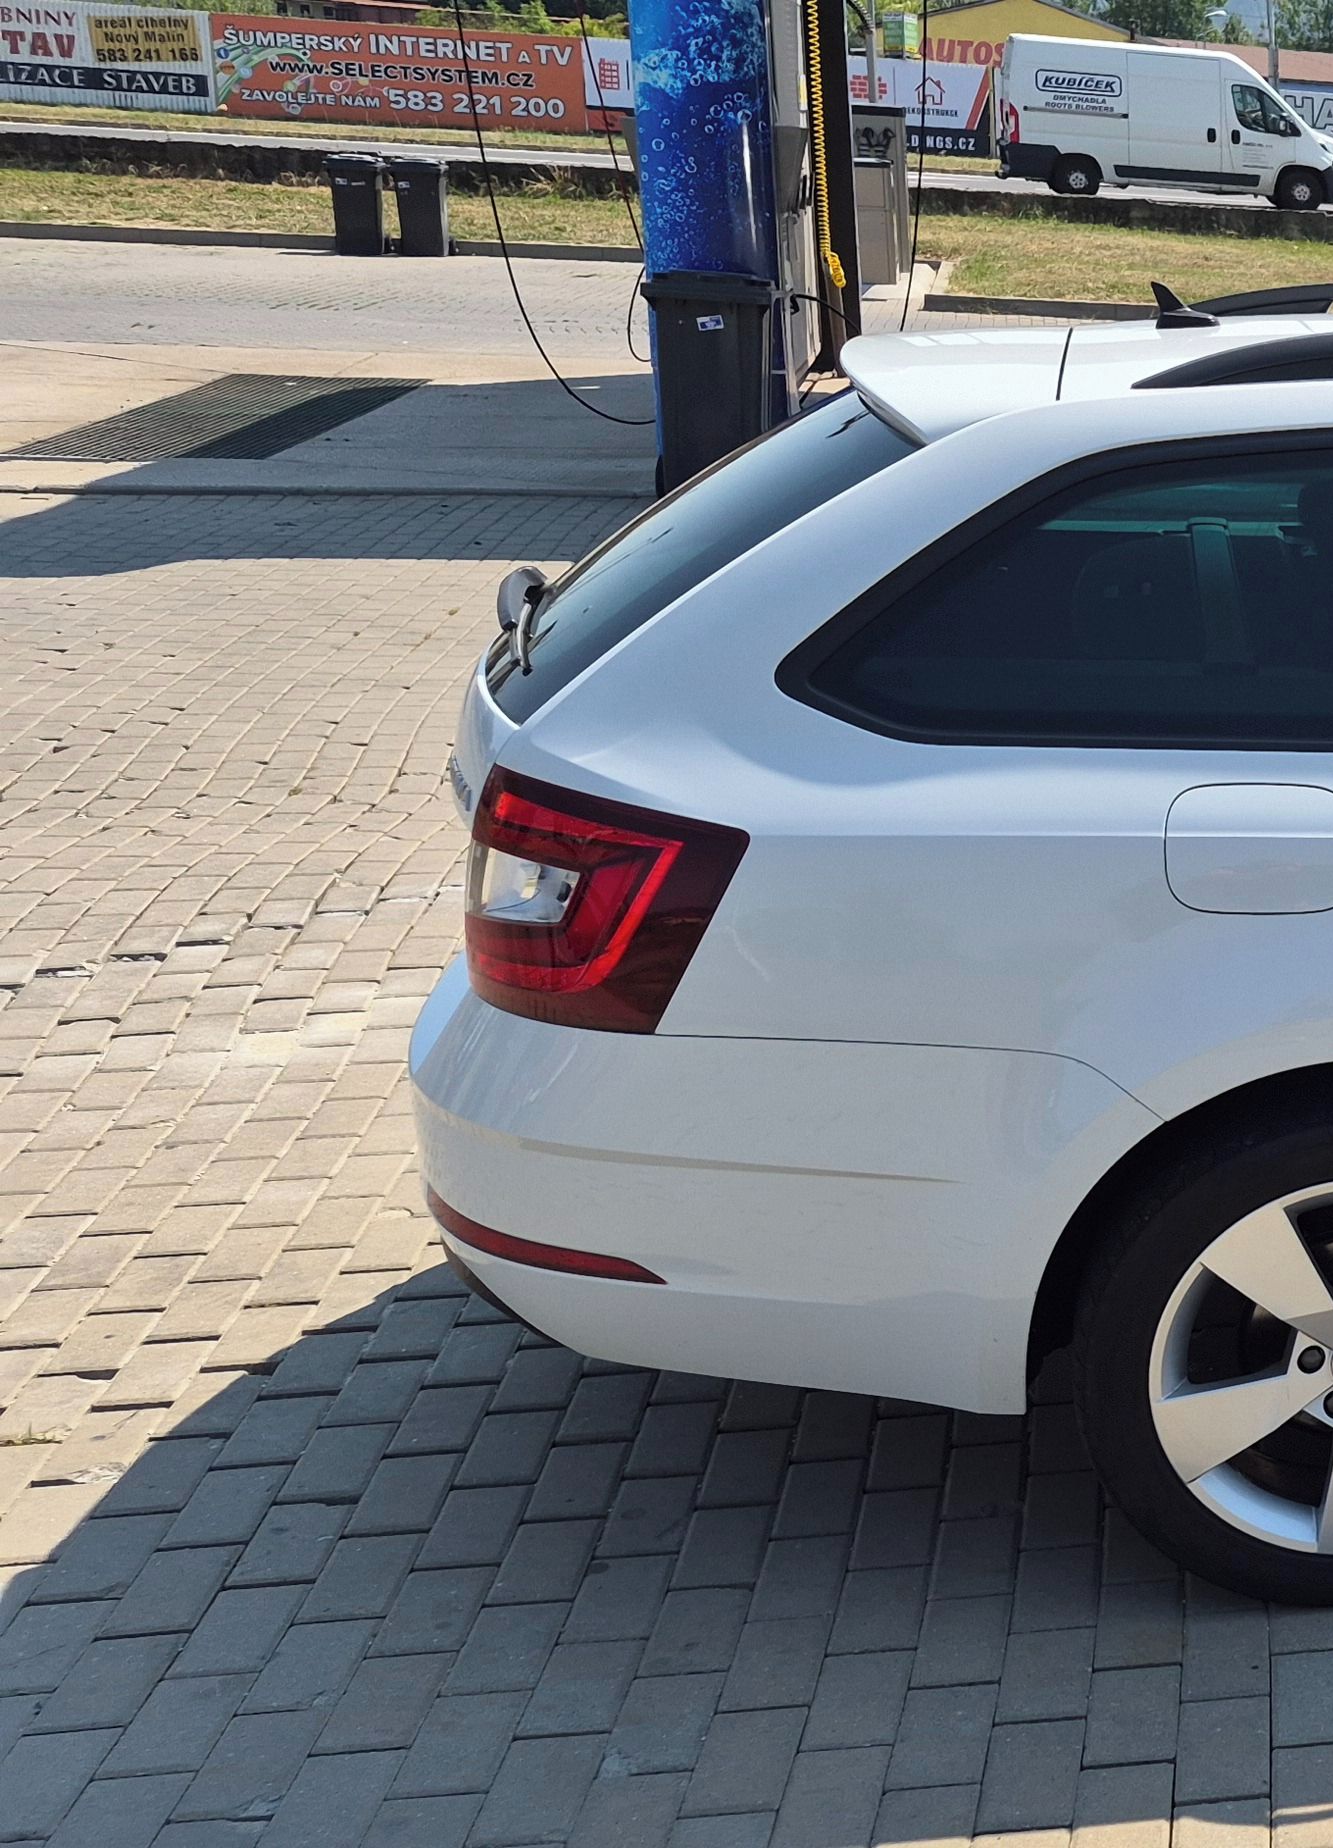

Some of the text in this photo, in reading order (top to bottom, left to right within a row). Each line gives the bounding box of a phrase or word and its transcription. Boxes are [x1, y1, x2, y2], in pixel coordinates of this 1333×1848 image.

[1, 7, 76, 27] BNINY
[94, 16, 132, 29] areál
[1, 30, 76, 59] TAV
[104, 31, 139, 45] Nový
[223, 25, 362, 52] ŠUMPERSKÝ
[370, 34, 513, 63] INTERNET
[534, 44, 572, 66] TV
[96, 48, 128, 62] 583
[135, 48, 161, 62] 241
[0, 63, 196, 94] IZACE STAVEB
[269, 61, 535, 88] www.SELECTSYSTEM.CZ
[1042, 75, 1116, 93] KUBÍČEK
[240, 88, 565, 119] ZAVOLEJTE NÁM 583 221 200
[1045, 102, 1114, 113] ROOTS BLOWERS
[1053, 95, 1107, 105] DMYCHADLA
[905, 133, 976, 151] DNGS.CZ
